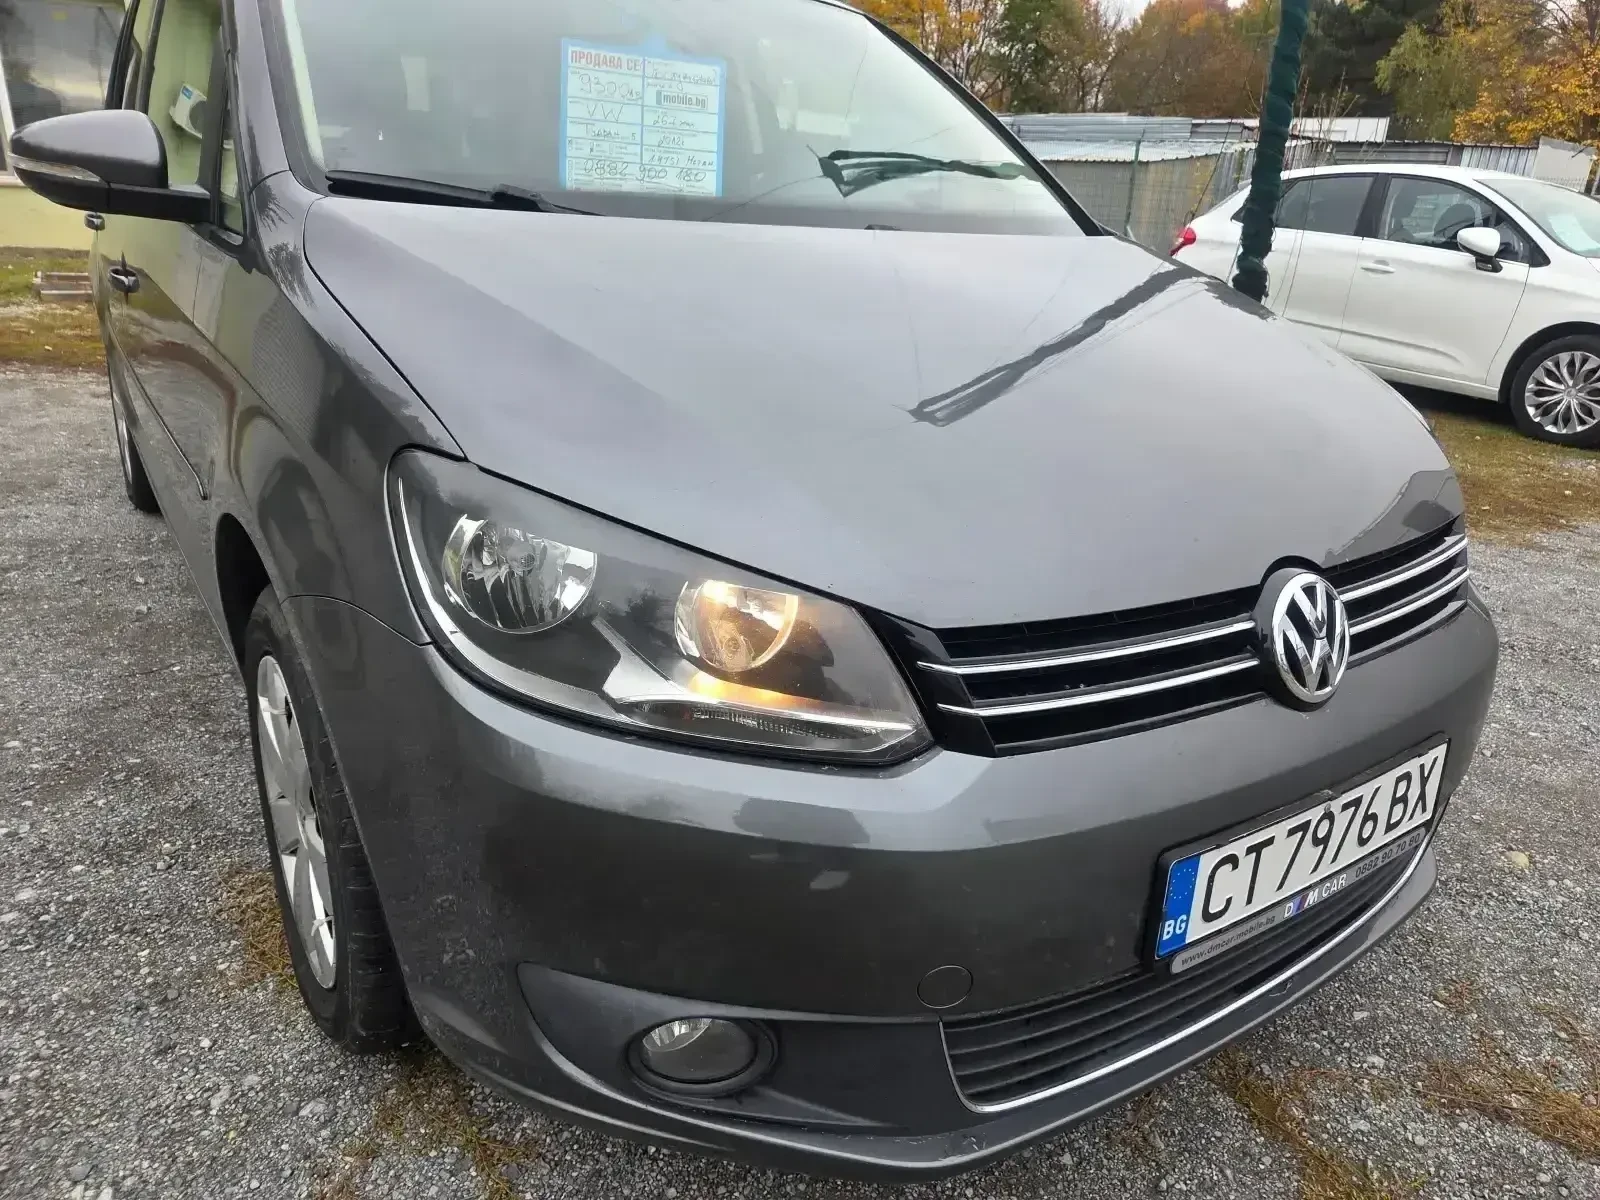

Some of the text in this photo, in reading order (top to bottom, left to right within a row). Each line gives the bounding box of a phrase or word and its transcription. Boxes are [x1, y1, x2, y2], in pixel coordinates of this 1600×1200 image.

[570, 49, 641, 71] ПРОДАВА СЕ
[586, 102, 625, 122] VW
[663, 94, 707, 109] mobile.bg
[583, 159, 629, 177] 0882
[675, 167, 707, 182] 180
[1202, 755, 1439, 923] CT 7976 BX
[1181, 915, 1276, 966] www.dmcar.mobile.bg
[1322, 873, 1347, 897] CAR
[1355, 857, 1380, 878] 0882
[1381, 848, 1393, 863] 90
[1395, 841, 1407, 854] 70
[1408, 833, 1421, 846] 80
[1162, 914, 1188, 941] BG
